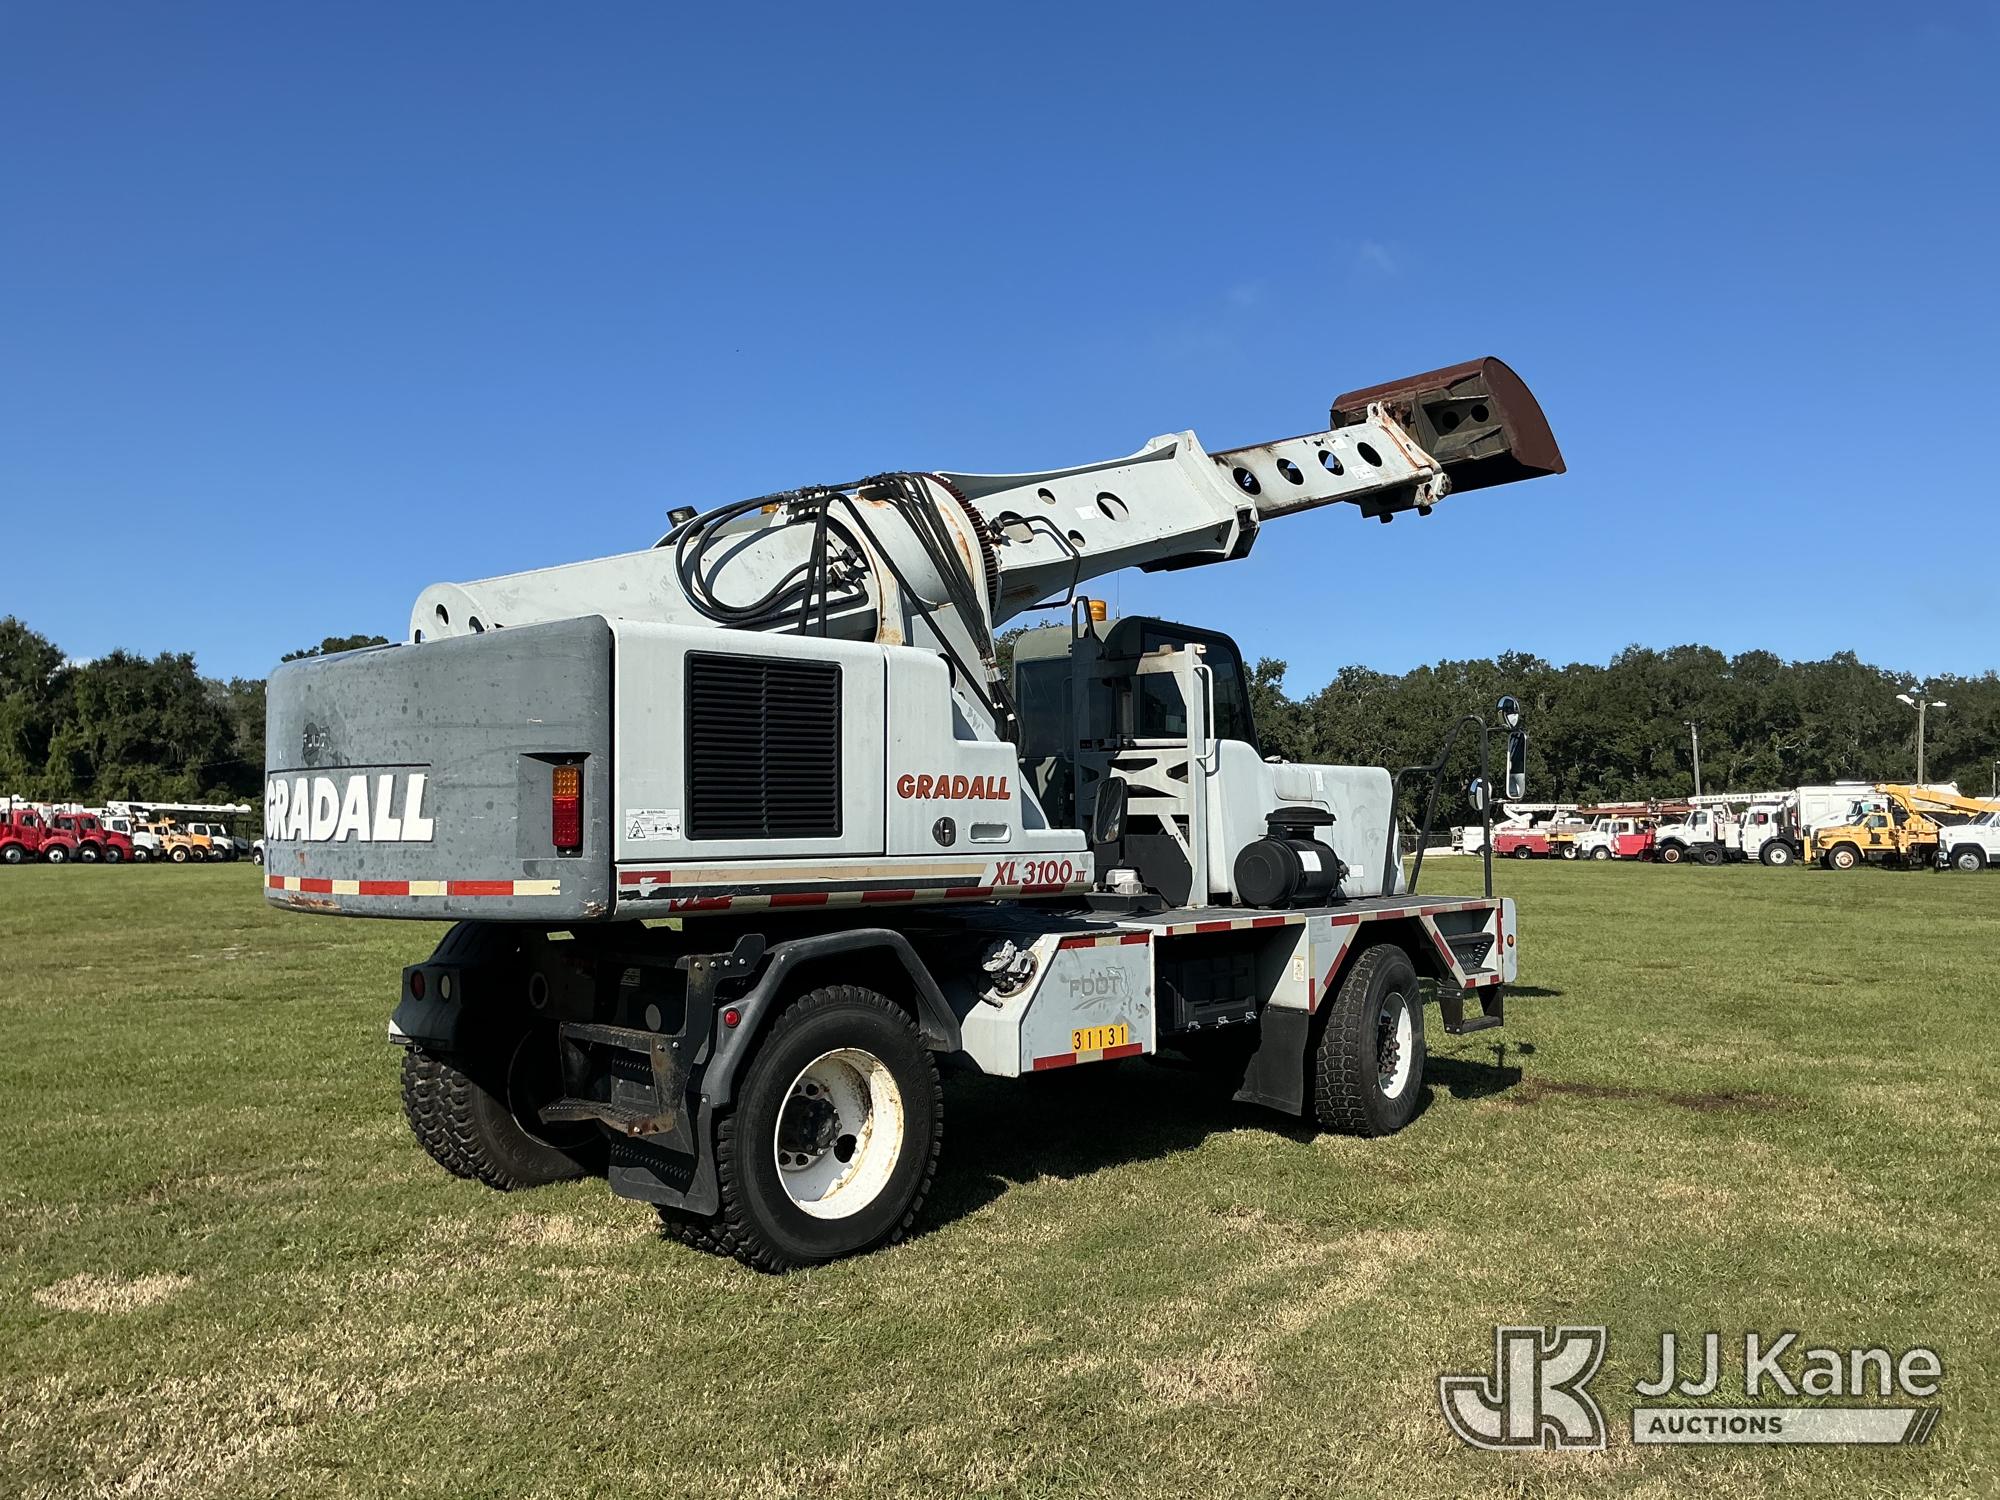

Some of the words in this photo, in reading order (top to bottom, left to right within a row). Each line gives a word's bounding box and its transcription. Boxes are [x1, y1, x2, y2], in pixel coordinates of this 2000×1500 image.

[897, 774, 1011, 800] GRADALL
[266, 774, 434, 842] GRADALL
[1074, 1026, 1124, 1050] 31131
